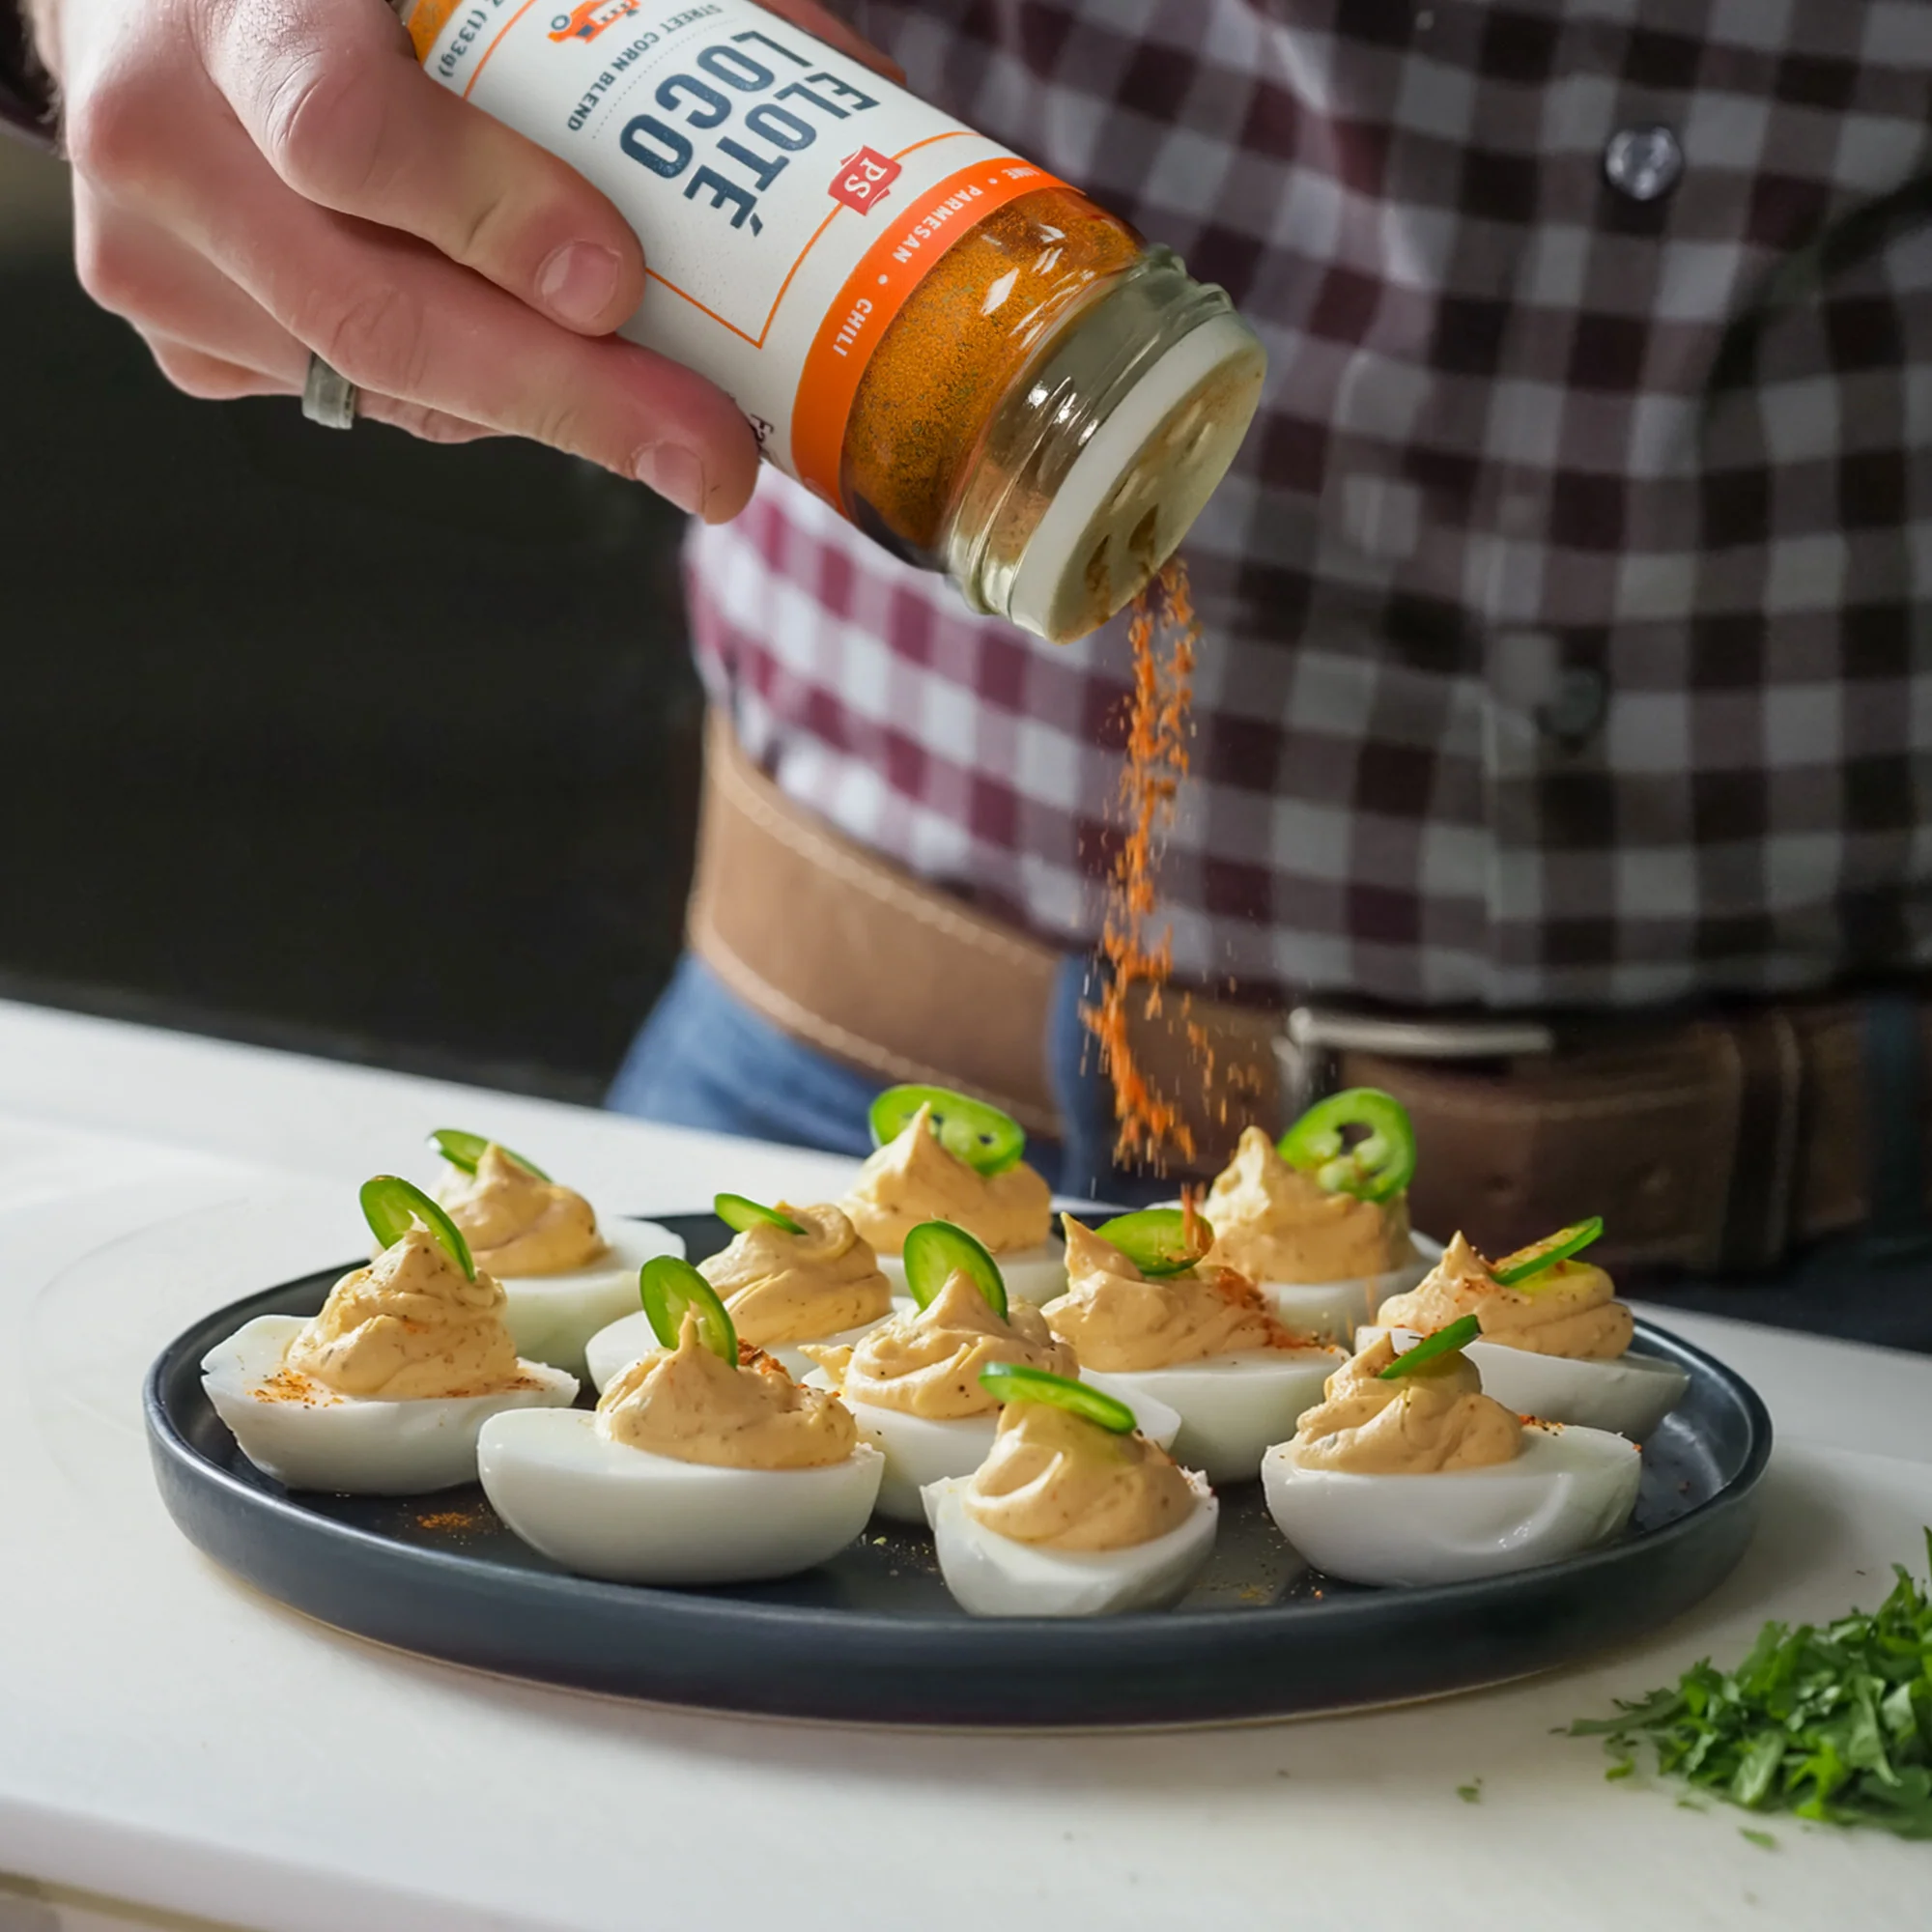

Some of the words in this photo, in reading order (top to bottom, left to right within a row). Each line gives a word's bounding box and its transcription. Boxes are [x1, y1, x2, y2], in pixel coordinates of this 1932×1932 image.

[438, 10, 488, 77] (133g)
[659, 4, 724, 34] STREET
[611, 32, 661, 71] CORN
[567, 71, 616, 131] BLEND
[619, 30, 813, 179] LOCO
[682, 71, 881, 237] ELOTÉ
[843, 156, 888, 199] PS
[892, 185, 983, 264] PARMESAN
[833, 298, 873, 356] CHILI
